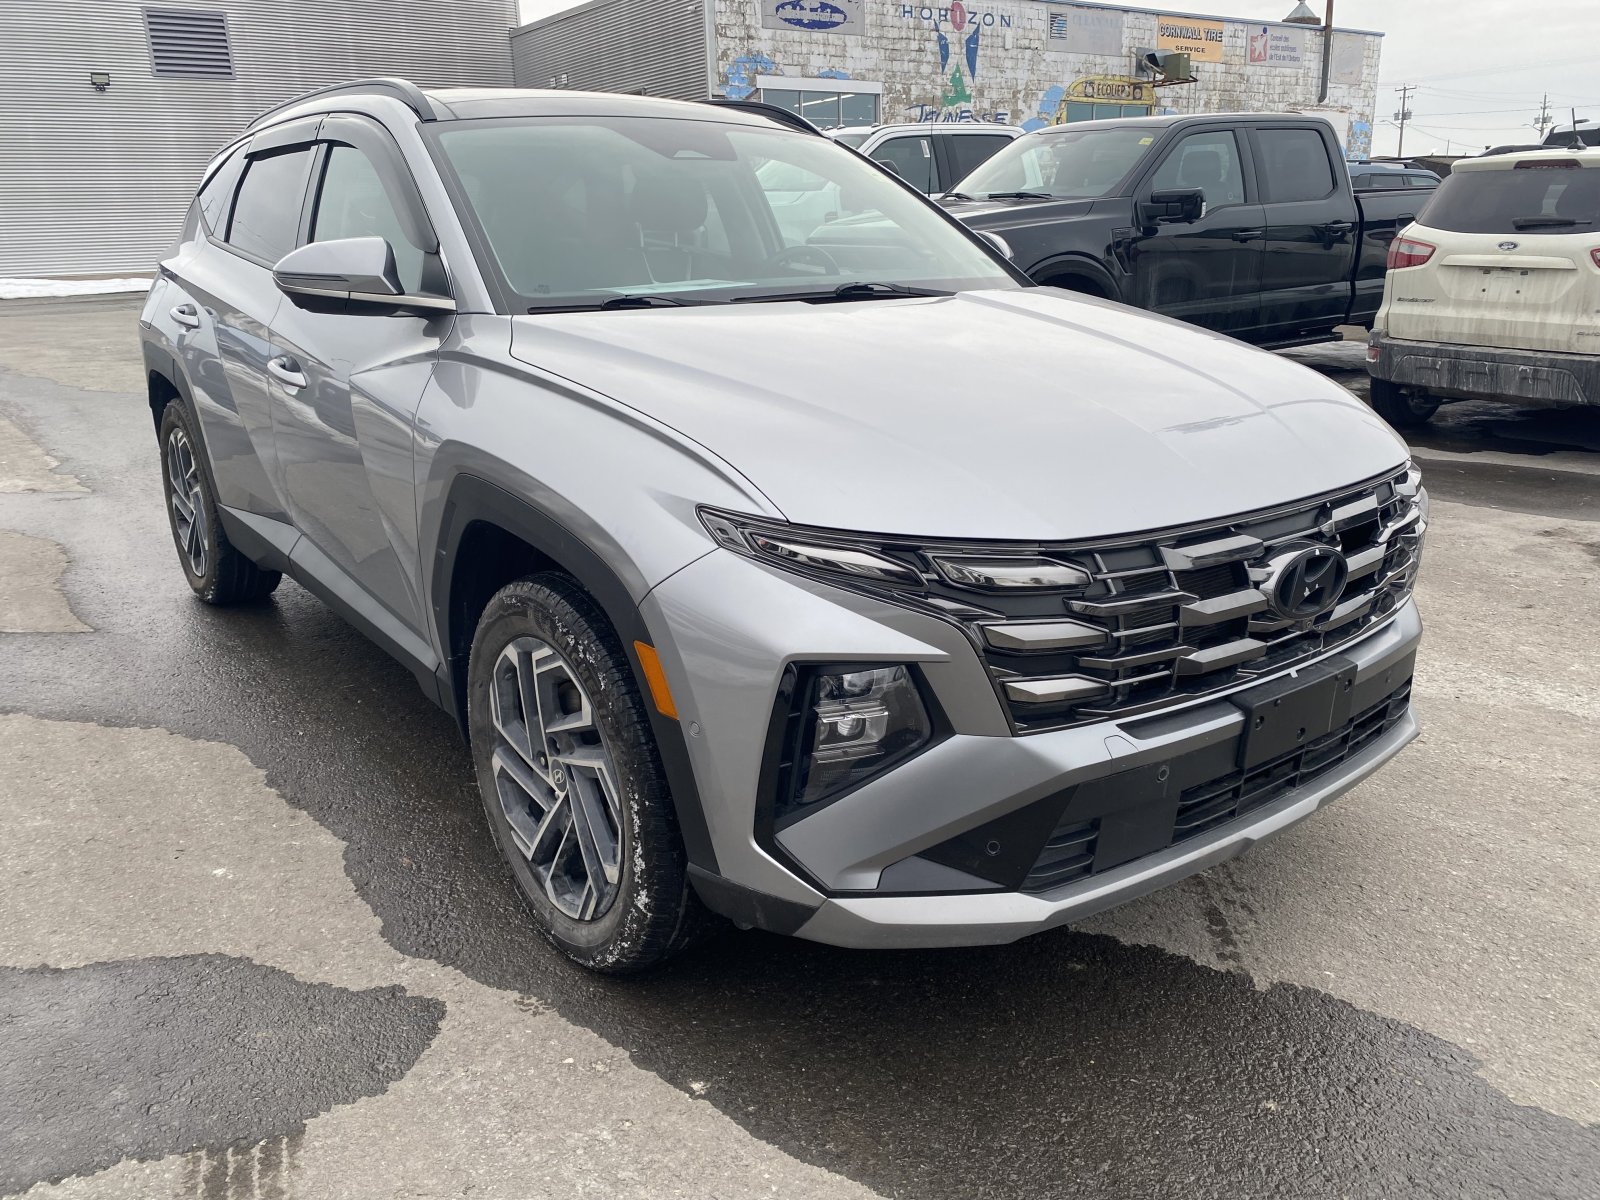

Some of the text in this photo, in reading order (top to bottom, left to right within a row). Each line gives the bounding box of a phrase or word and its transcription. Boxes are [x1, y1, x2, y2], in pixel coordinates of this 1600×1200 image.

[902, 4, 1012, 28] HORIZON
[1159, 23, 1224, 43] CORNWALL TIRE
[1175, 45, 1206, 54] SERVICE
